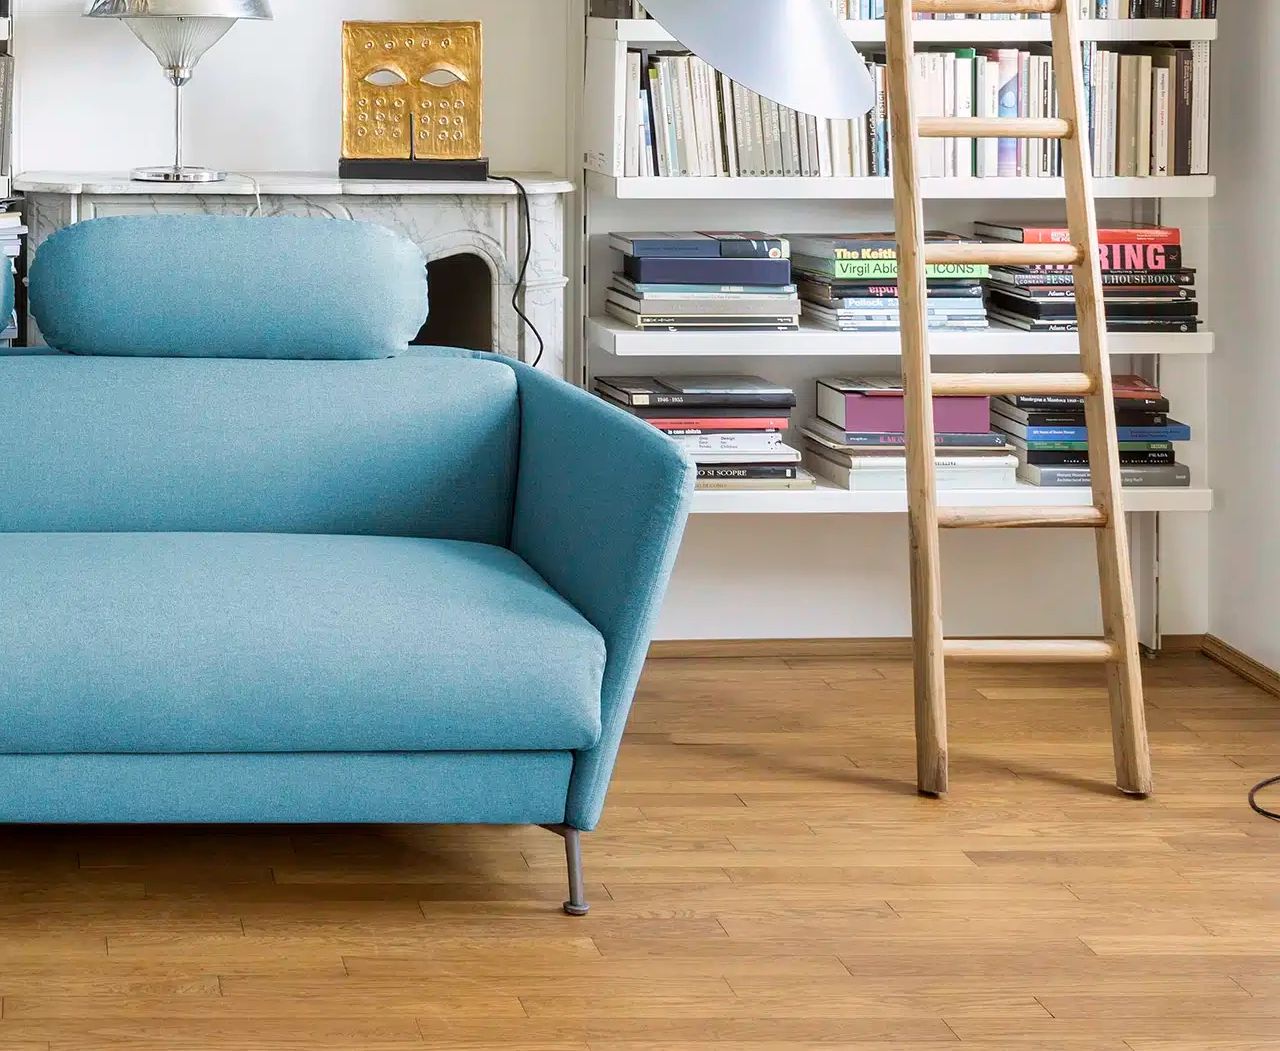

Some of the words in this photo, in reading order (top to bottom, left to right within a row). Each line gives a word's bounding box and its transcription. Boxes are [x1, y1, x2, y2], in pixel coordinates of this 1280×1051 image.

[861, 248, 897, 259] Keith
[839, 262, 870, 276] Virgil
[872, 262, 898, 274] Ablo
[932, 263, 975, 274] ICONS
[1112, 274, 1177, 284] HOUSEBOOK
